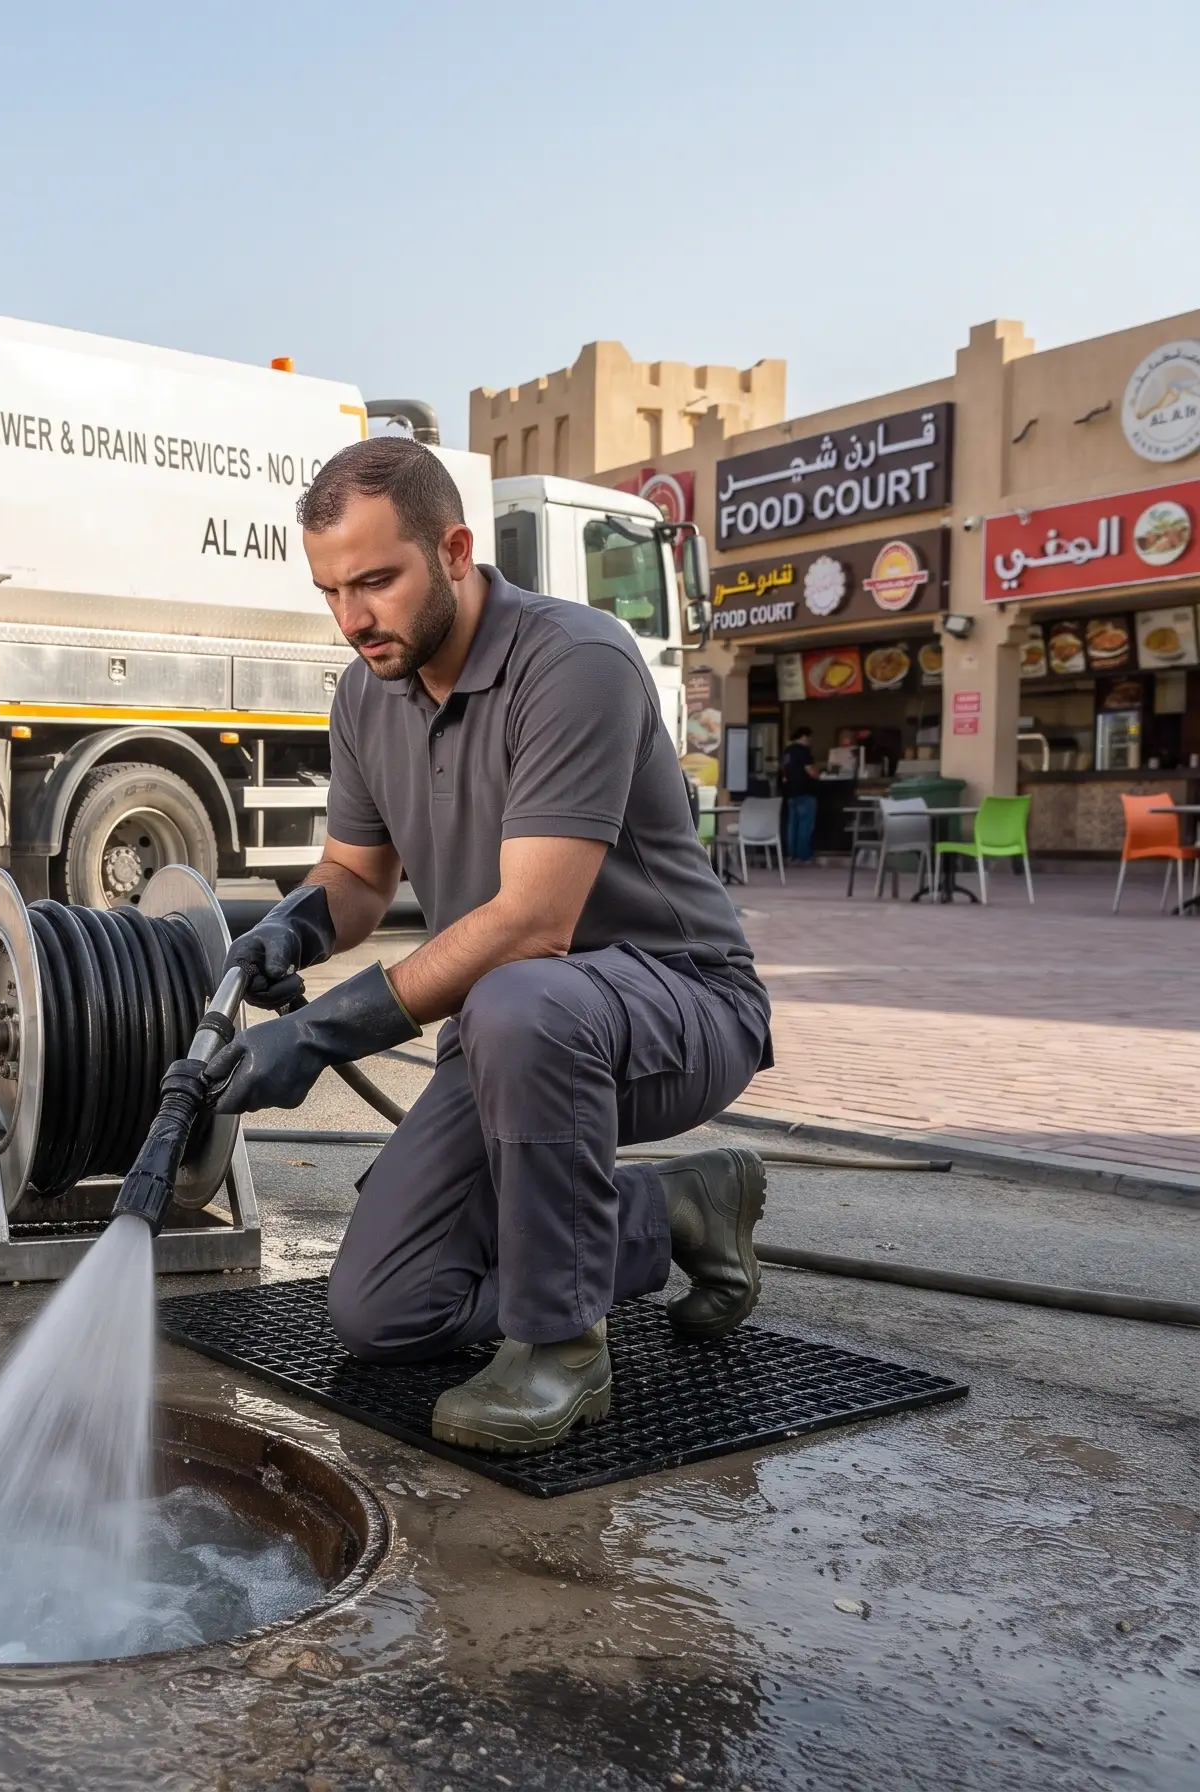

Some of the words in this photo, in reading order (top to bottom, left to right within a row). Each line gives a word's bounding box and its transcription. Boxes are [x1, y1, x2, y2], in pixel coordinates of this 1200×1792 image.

[60, 420, 75, 455] &
[81, 424, 148, 465] DRAIN
[154, 434, 251, 480] SERVICES
[268, 452, 295, 486] NO
[720, 492, 805, 539] FOOD
[812, 461, 935, 521] COURT
[201, 517, 237, 557] AL
[244, 522, 287, 562] AIN
[712, 608, 747, 630] FOOD
[749, 601, 796, 625] COURT
